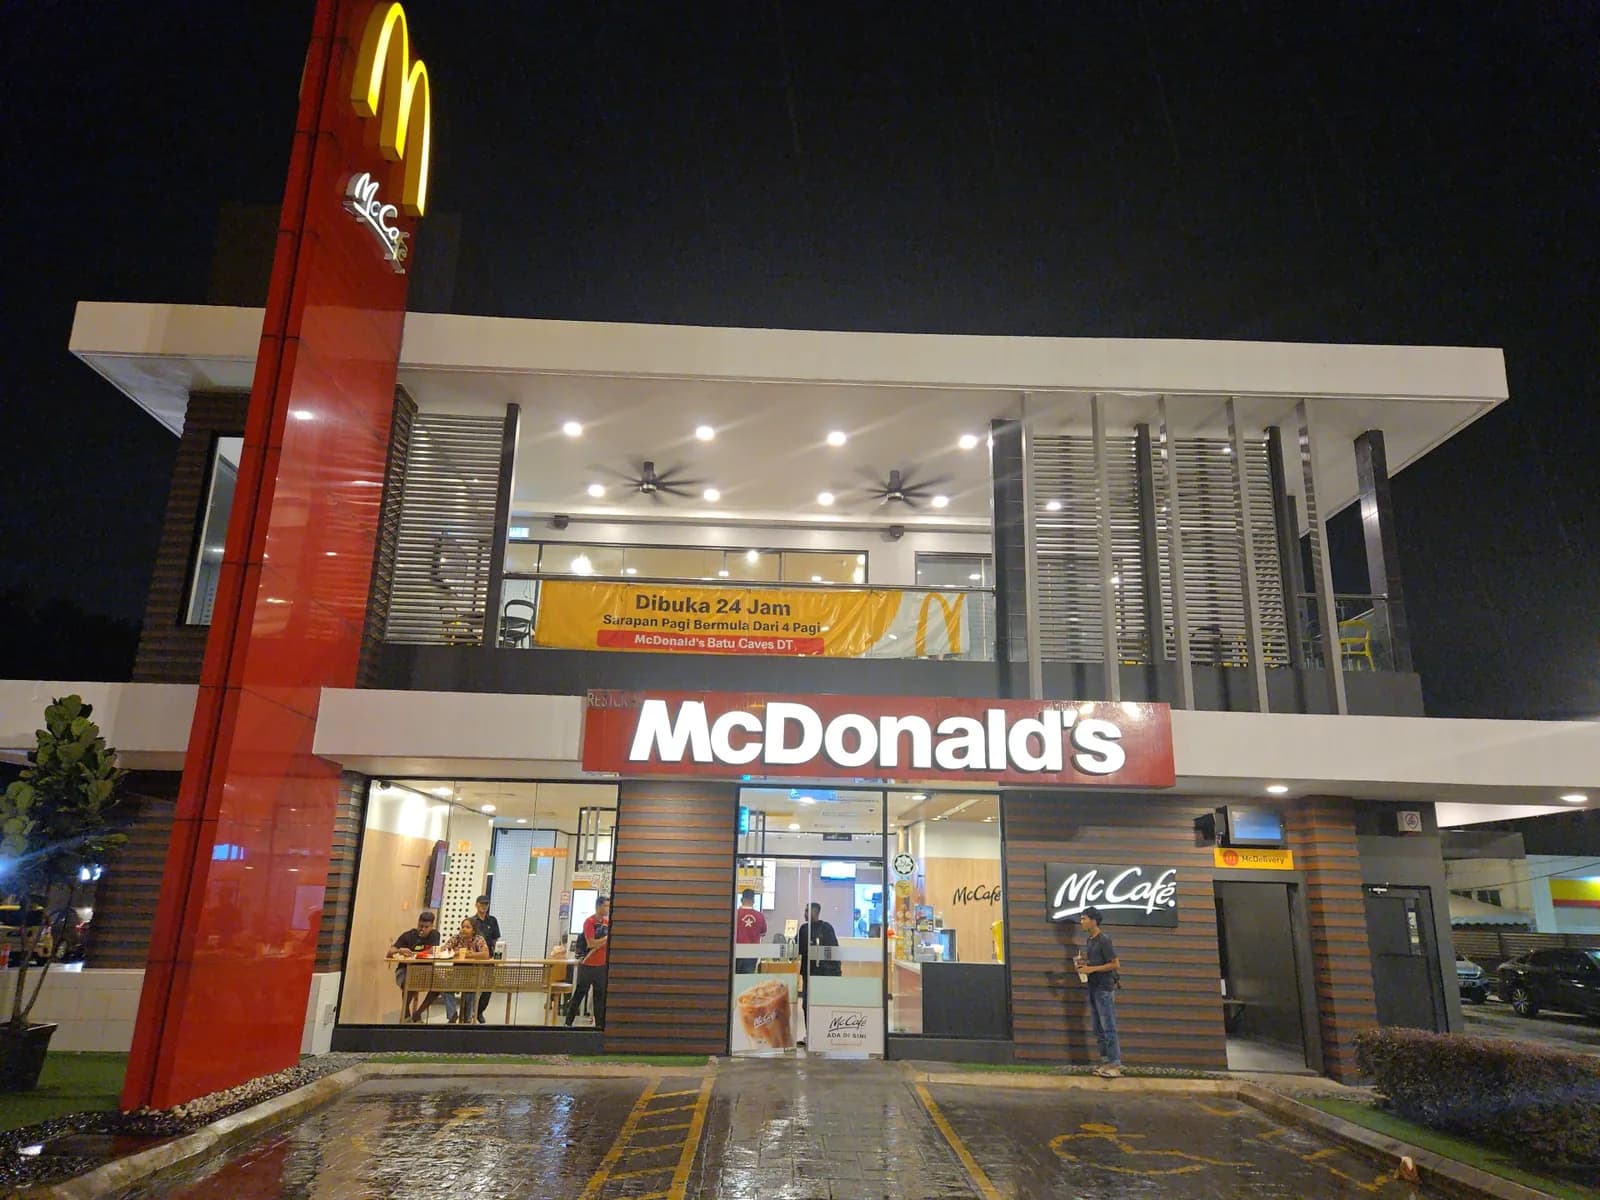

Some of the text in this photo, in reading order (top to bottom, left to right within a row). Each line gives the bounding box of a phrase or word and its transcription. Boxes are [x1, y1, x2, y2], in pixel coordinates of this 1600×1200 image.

[635, 594, 791, 616] Dibuka 24 Jam
[603, 614, 821, 635] Sarapan Pagi Bermula Dari 4 Pagi
[634, 634, 793, 650] McDonald's Batu Caves DT
[628, 699, 1127, 775] McDonald's
[1241, 854, 1286, 865] McDelivery
